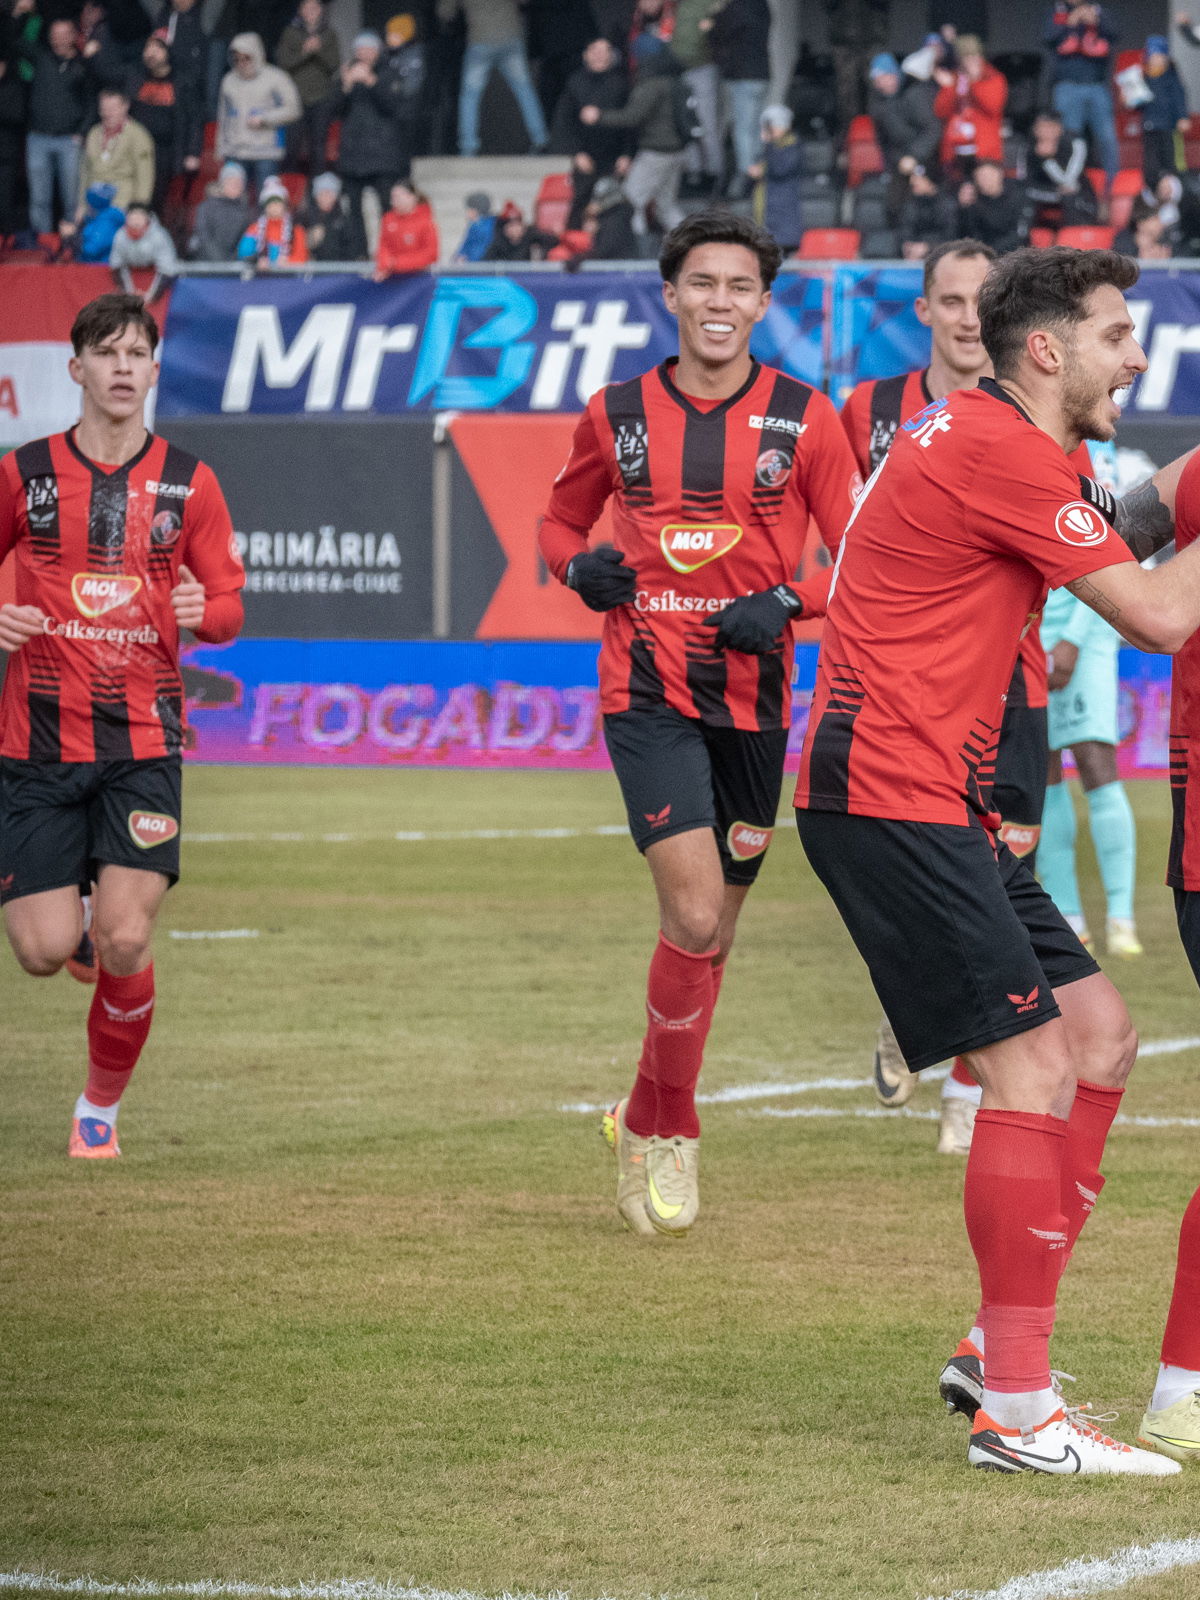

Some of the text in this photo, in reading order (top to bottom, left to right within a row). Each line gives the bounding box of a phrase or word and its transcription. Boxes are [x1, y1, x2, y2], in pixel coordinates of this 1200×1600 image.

[222, 277, 652, 413] MrBit
[764, 416, 808, 434] ZAEV
[233, 525, 402, 568] PRIMĂRIA
[671, 530, 716, 552] MOL
[81, 578, 118, 597] MOL
[42, 615, 159, 645] Csíkszereda
[249, 681, 598, 750] FOGADJ
[135, 815, 168, 833] MOL
